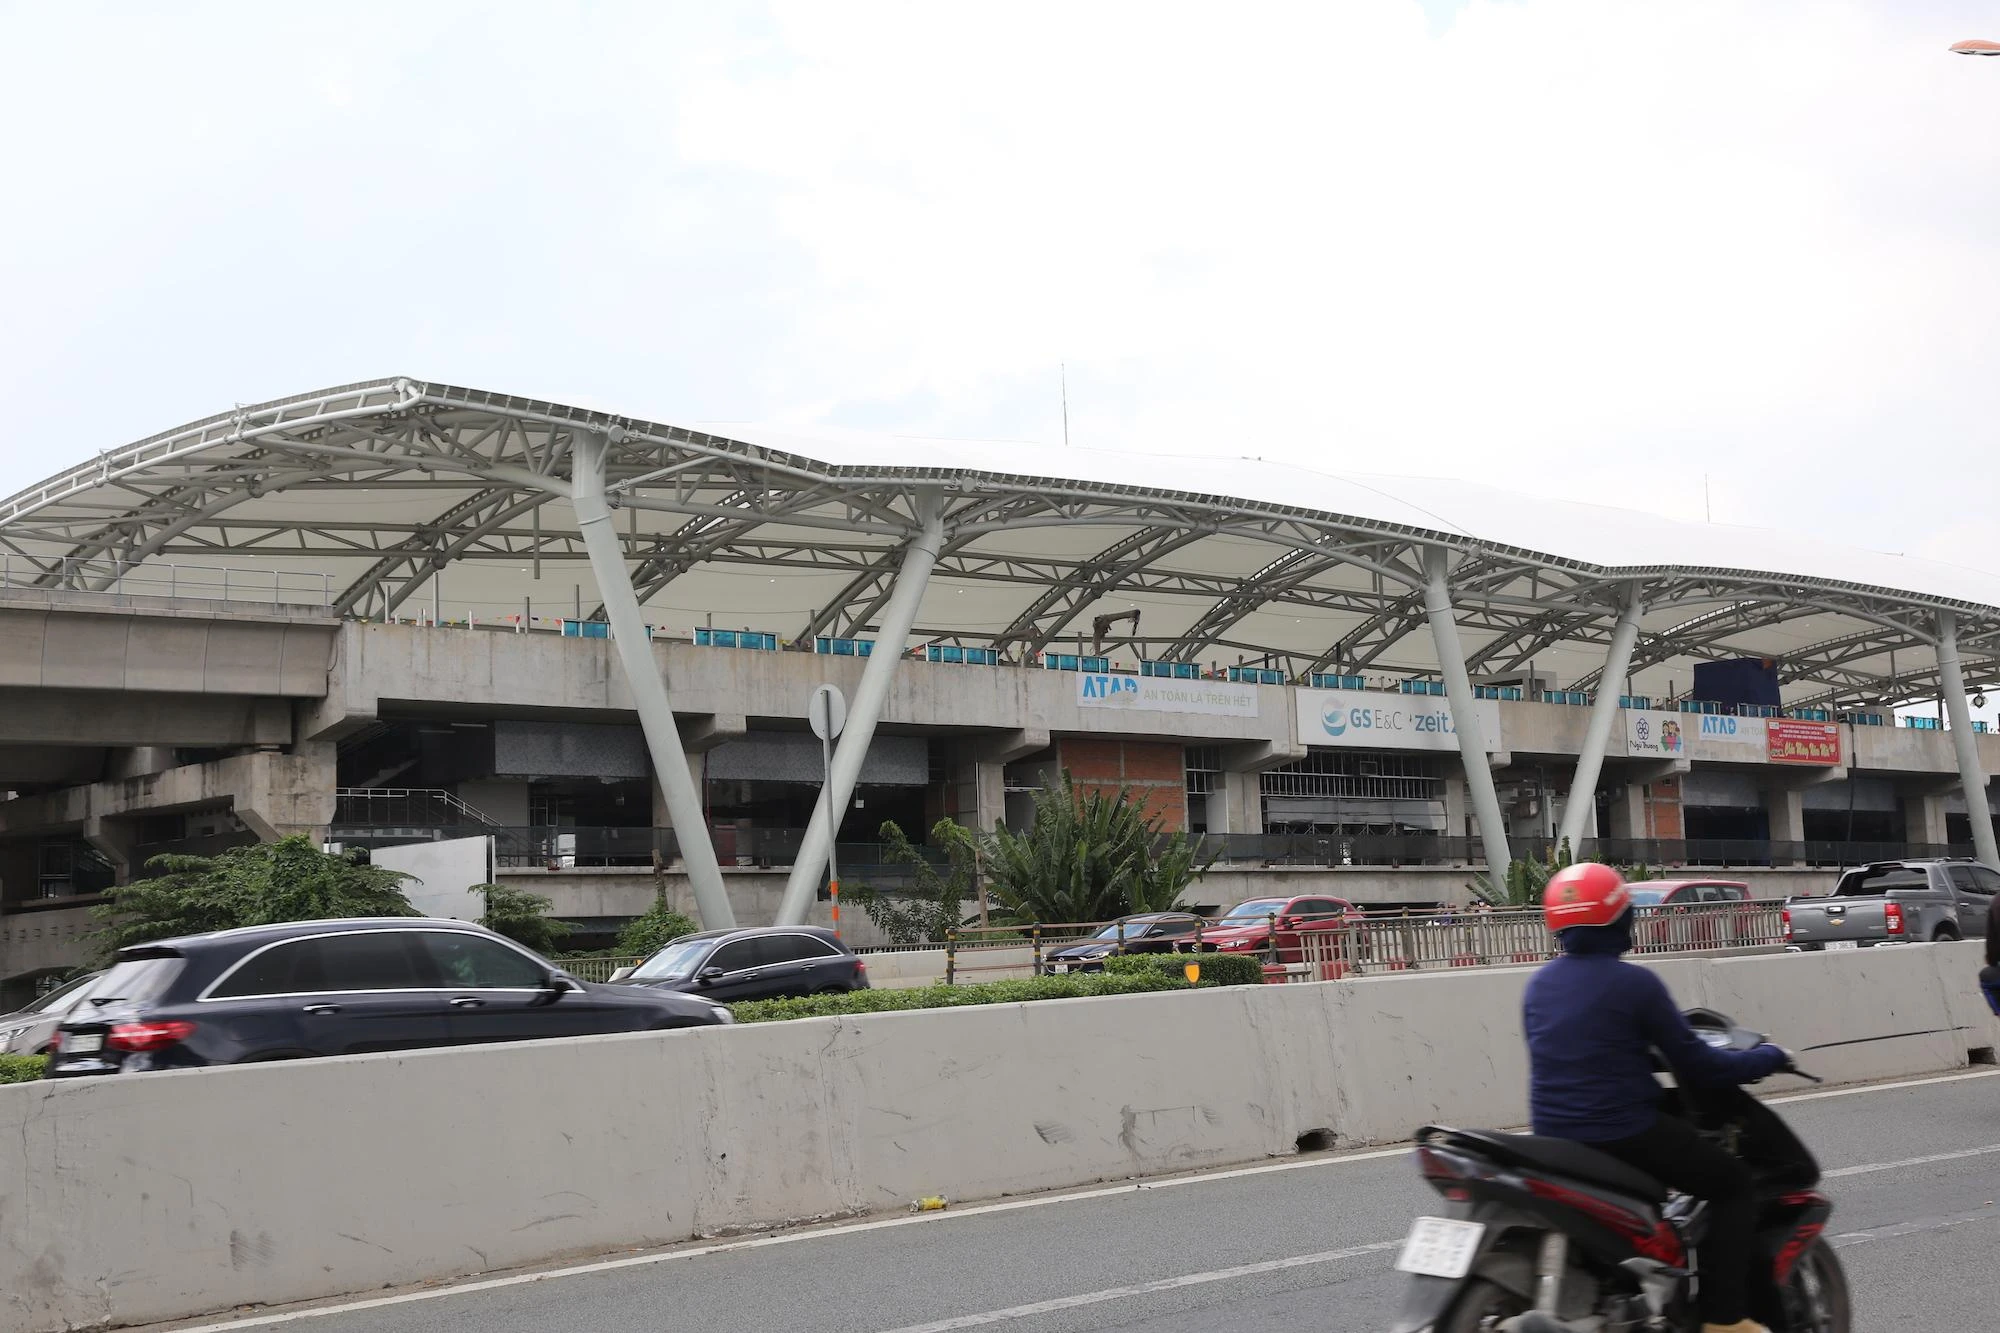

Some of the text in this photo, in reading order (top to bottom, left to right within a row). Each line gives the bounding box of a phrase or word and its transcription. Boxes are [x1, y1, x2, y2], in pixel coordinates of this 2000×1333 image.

[1143, 689, 1158, 700] AN
[1350, 708, 1372, 728] GS
[1375, 709, 1403, 730] E&C
[1702, 715, 1736, 735] ATAD
